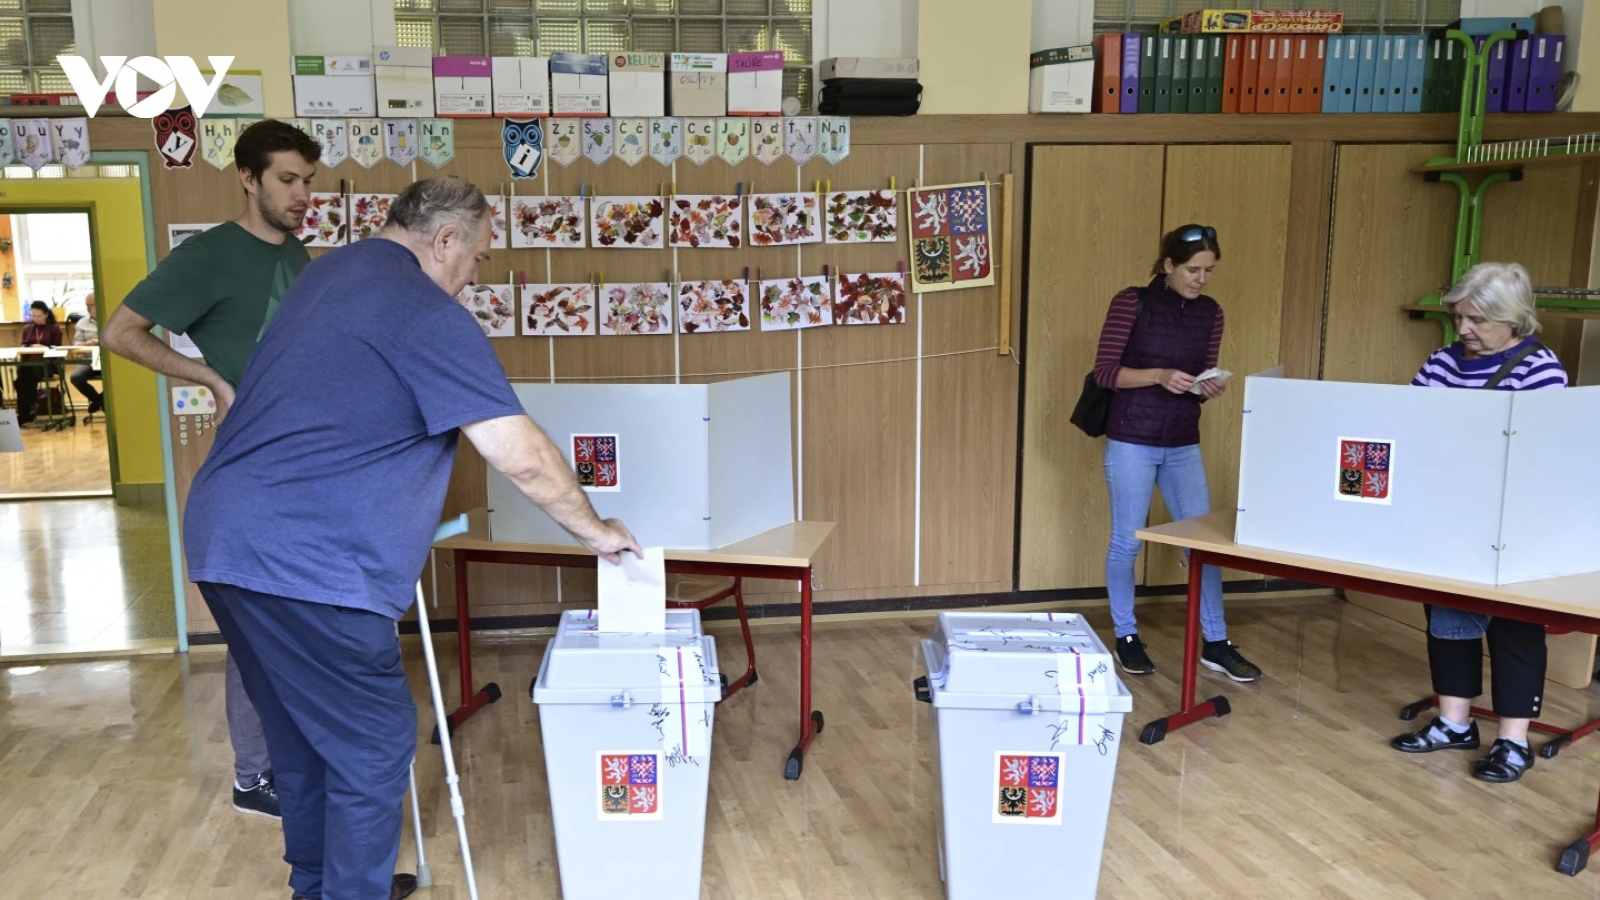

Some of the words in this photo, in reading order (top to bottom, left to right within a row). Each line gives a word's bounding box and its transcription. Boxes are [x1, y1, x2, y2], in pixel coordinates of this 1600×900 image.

[17, 125, 26, 137] U
[38, 127, 46, 136] u
[55, 125, 63, 137] Y
[205, 125, 215, 137] H
[223, 125, 231, 136] h
[316, 124, 324, 136] R
[336, 126, 343, 136] r
[352, 125, 361, 136] D
[370, 124, 378, 136] d
[387, 123, 394, 135] T
[407, 123, 414, 135] t
[423, 124, 433, 135] N
[441, 127, 450, 136] n
[688, 122, 695, 134] C
[704, 125, 711, 134] c
[722, 122, 728, 134] J
[740, 123, 745, 136] j
[518, 149, 531, 166] i
